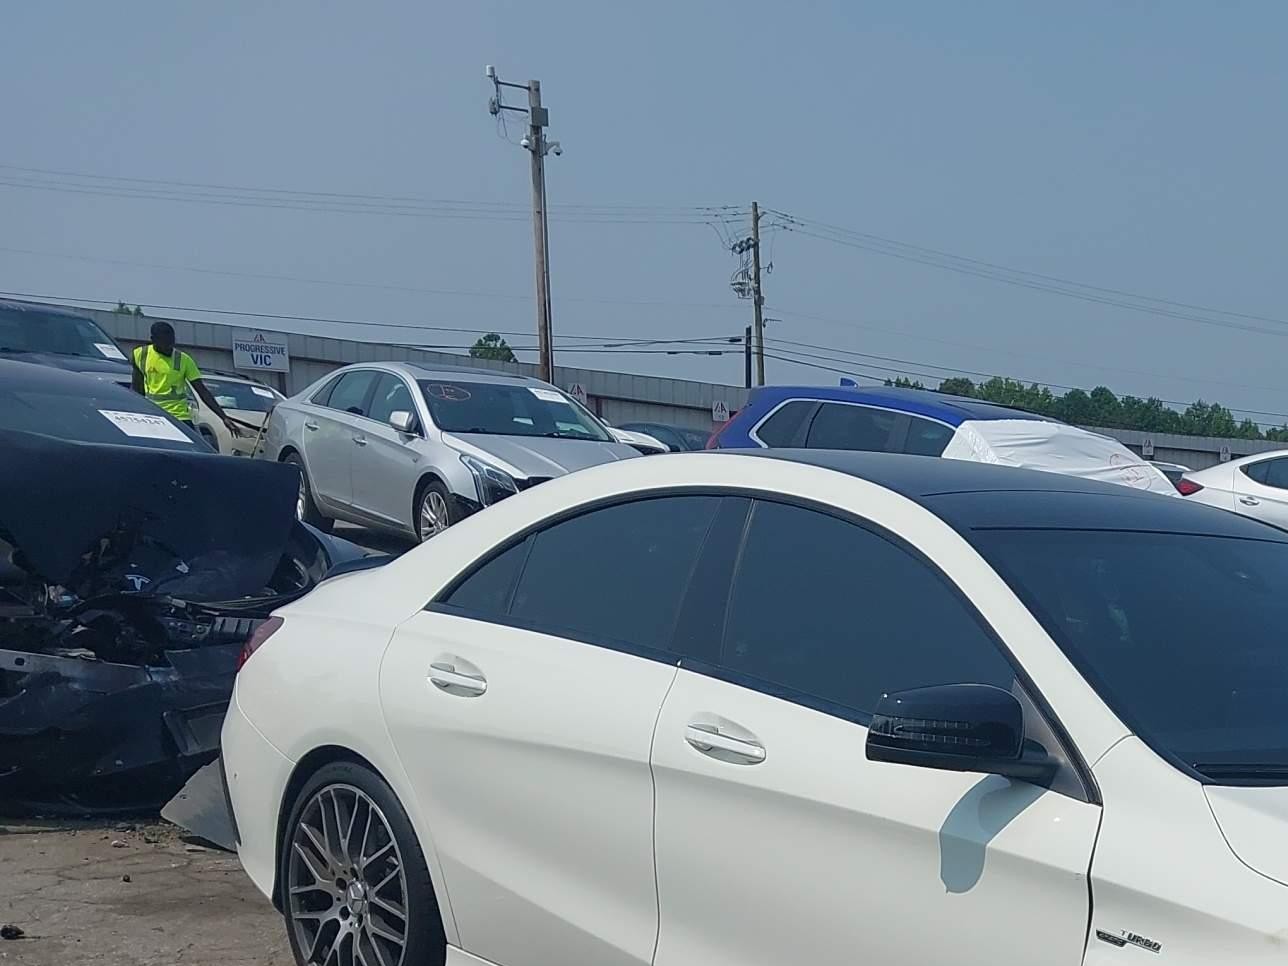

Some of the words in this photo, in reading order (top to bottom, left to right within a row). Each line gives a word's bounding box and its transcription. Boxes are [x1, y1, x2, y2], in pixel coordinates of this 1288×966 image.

[234, 343, 286, 356] PROGRESSIVE
[251, 353, 272, 366] VIC
[1121, 929, 1162, 951] TURBO
